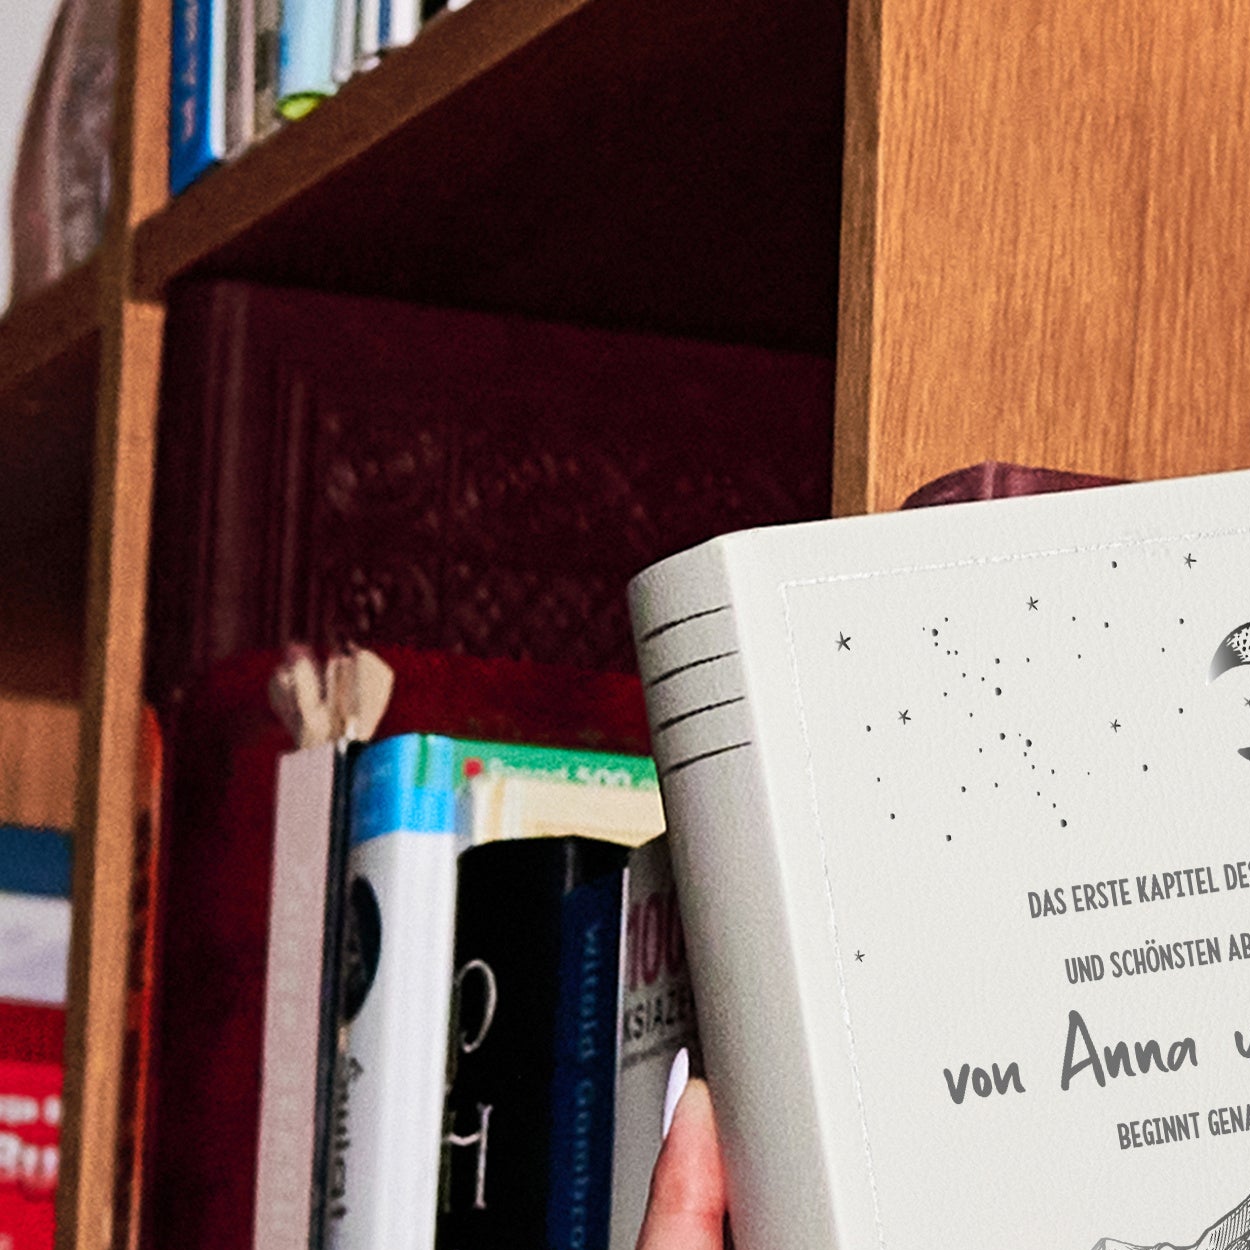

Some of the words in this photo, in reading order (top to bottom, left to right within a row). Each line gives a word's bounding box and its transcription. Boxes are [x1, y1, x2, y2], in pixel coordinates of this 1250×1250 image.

[1027, 887, 1067, 919] DAS
[1071, 878, 1133, 913] ERSTE
[1135, 866, 1220, 903] KAPITEL
[1064, 954, 1105, 985] UND
[1109, 936, 1222, 978] SCHÖNSTEN
[943, 1061, 1027, 1105] von
[1060, 1010, 1199, 1092] Anna
[1116, 1111, 1200, 1150] BEGINNT
